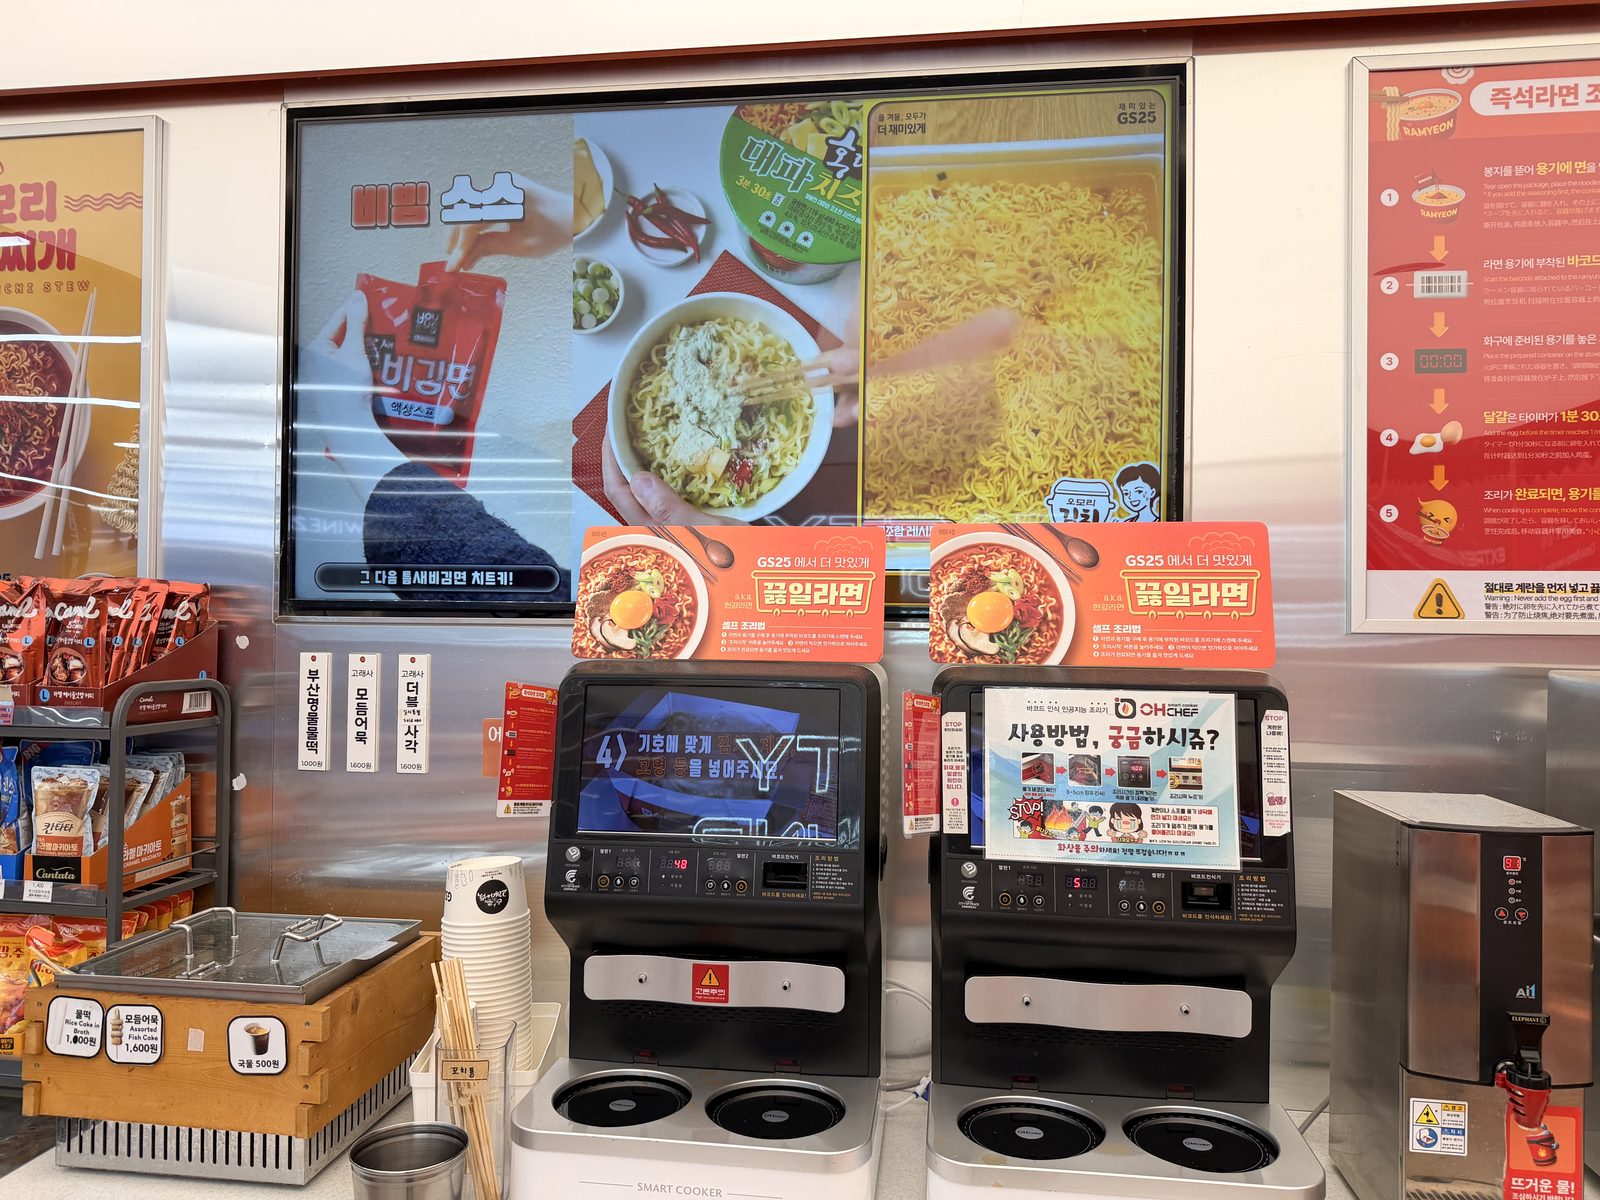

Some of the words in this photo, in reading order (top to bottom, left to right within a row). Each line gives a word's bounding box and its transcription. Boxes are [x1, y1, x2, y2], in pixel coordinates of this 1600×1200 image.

[1490, 82, 1579, 111] 즉석라면
[905, 112, 927, 122] 모두가
[1116, 111, 1157, 125] GS25
[878, 124, 887, 135] 더
[888, 122, 926, 135] 재미있게
[1402, 118, 1454, 138] RAMYEON
[1484, 166, 1513, 177] 봉지를
[1515, 165, 1534, 176] 뜯어
[1536, 162, 1572, 176] 용기에
[1574, 161, 1597, 175] 면을
[1386, 193, 1393, 202] 1
[1419, 207, 1459, 219] RAMYEON
[1483, 259, 1503, 270] 라면
[1505, 258, 1534, 270] 용기에
[1536, 257, 1566, 268] 부착된
[43, 280, 90, 293] STEW
[1386, 281, 1394, 290] 2
[1483, 335, 1513, 347] 화구에
[1515, 335, 1544, 346] 준비된
[1546, 334, 1575, 346] 용기를
[1577, 334, 1597, 345] 놓은
[1386, 356, 1393, 366] 3
[1419, 354, 1463, 368] 00:00
[1483, 411, 1517, 424] 달걀은
[1518, 412, 1559, 423] 타이머가
[1560, 410, 1579, 423] 1분
[1386, 433, 1393, 443] 4
[1483, 490, 1514, 501] 조리가
[1515, 487, 1566, 503] 완료되면,
[1066, 498, 1096, 507] 오모리
[1385, 508, 1393, 518] 5
[1502, 507, 1525, 515] cooking
[757, 557, 791, 568] GS25
[794, 557, 816, 569] 에서
[820, 557, 832, 568] 더
[834, 557, 870, 569] 맛있게
[1125, 555, 1164, 567] GS25
[1168, 555, 1192, 568] 에서
[1197, 556, 1210, 568] 더
[1212, 555, 1252, 568] 맛있게
[360, 571, 370, 585] 그
[374, 570, 398, 585] 다음
[402, 570, 467, 586] 틈새비김면
[471, 571, 513, 586] 치트키!
[1484, 582, 1514, 594] 절대로
[1515, 582, 1545, 594] 계란을
[1547, 582, 1567, 594] 먼저
[1569, 582, 1589, 594] 넣고
[763, 582, 864, 607] 끓일라면
[1135, 582, 1248, 607] 끓일라면
[1484, 595, 1511, 603] Warning
[1560, 596, 1573, 604] egg
[1092, 623, 1111, 633] 셀프
[1113, 623, 1142, 634] 조리법
[351, 670, 374, 678] 고래사
[401, 670, 424, 678] 고래사
[1026, 704, 1045, 713] 바코드
[1047, 705, 1060, 713] 인식
[1061, 705, 1087, 714] 인공지능
[1089, 705, 1109, 714] 조리기
[1139, 702, 1166, 717] OH
[1166, 708, 1199, 717] CHEF
[354, 688, 369, 745] 모듬어묵
[1008, 723, 1099, 749] 사용방법,
[1108, 725, 1220, 751] 궁금하시쥬?
[638, 734, 679, 754] 기호에
[684, 734, 712, 754] 맞게
[42, 822, 75, 835] 칸타타
[1057, 842, 1081, 854] 화상을
[1083, 844, 1120, 856] 주의하세요!
[1121, 847, 1135, 856] 정말
[674, 859, 688, 869] 48
[35, 868, 76, 880] Cantata
[695, 987, 726, 996] 고온주의
[75, 1009, 92, 1021] 물떡
[125, 1014, 159, 1025] 모듬어묵
[65, 1018, 78, 1026] Rice
[78, 1020, 93, 1028] Cake
[94, 1021, 100, 1029] in
[73, 1028, 90, 1036] Broth
[125, 1043, 158, 1054] 1,600원
[237, 1059, 254, 1069] 국물
[255, 1059, 280, 1069] 500원
[637, 1181, 673, 1196] SMART
[675, 1184, 723, 1199] COOKER
[1511, 1177, 1553, 1194] 뜨거운
[1556, 1179, 1575, 1195] 물!
